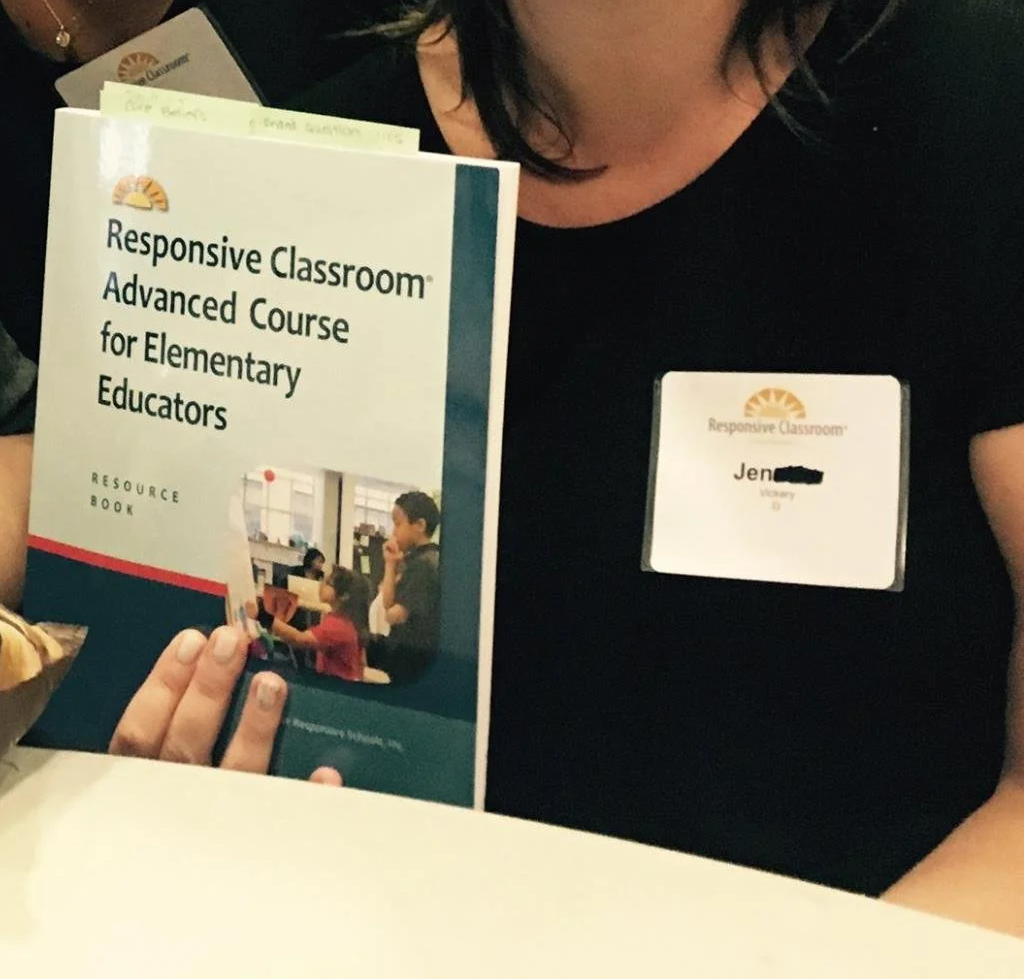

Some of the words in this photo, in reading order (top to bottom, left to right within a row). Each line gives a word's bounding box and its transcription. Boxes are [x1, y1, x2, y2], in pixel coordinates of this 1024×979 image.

[107, 218, 262, 274] Responsive
[102, 271, 237, 324] Advanced
[250, 298, 350, 344] Course
[100, 320, 138, 357] for
[144, 331, 302, 399] Elementary
[98, 374, 228, 431] Educators
[707, 417, 776, 438] Responsive
[90, 494, 133, 516] BOOK
[91, 471, 179, 503] RESOURCE
